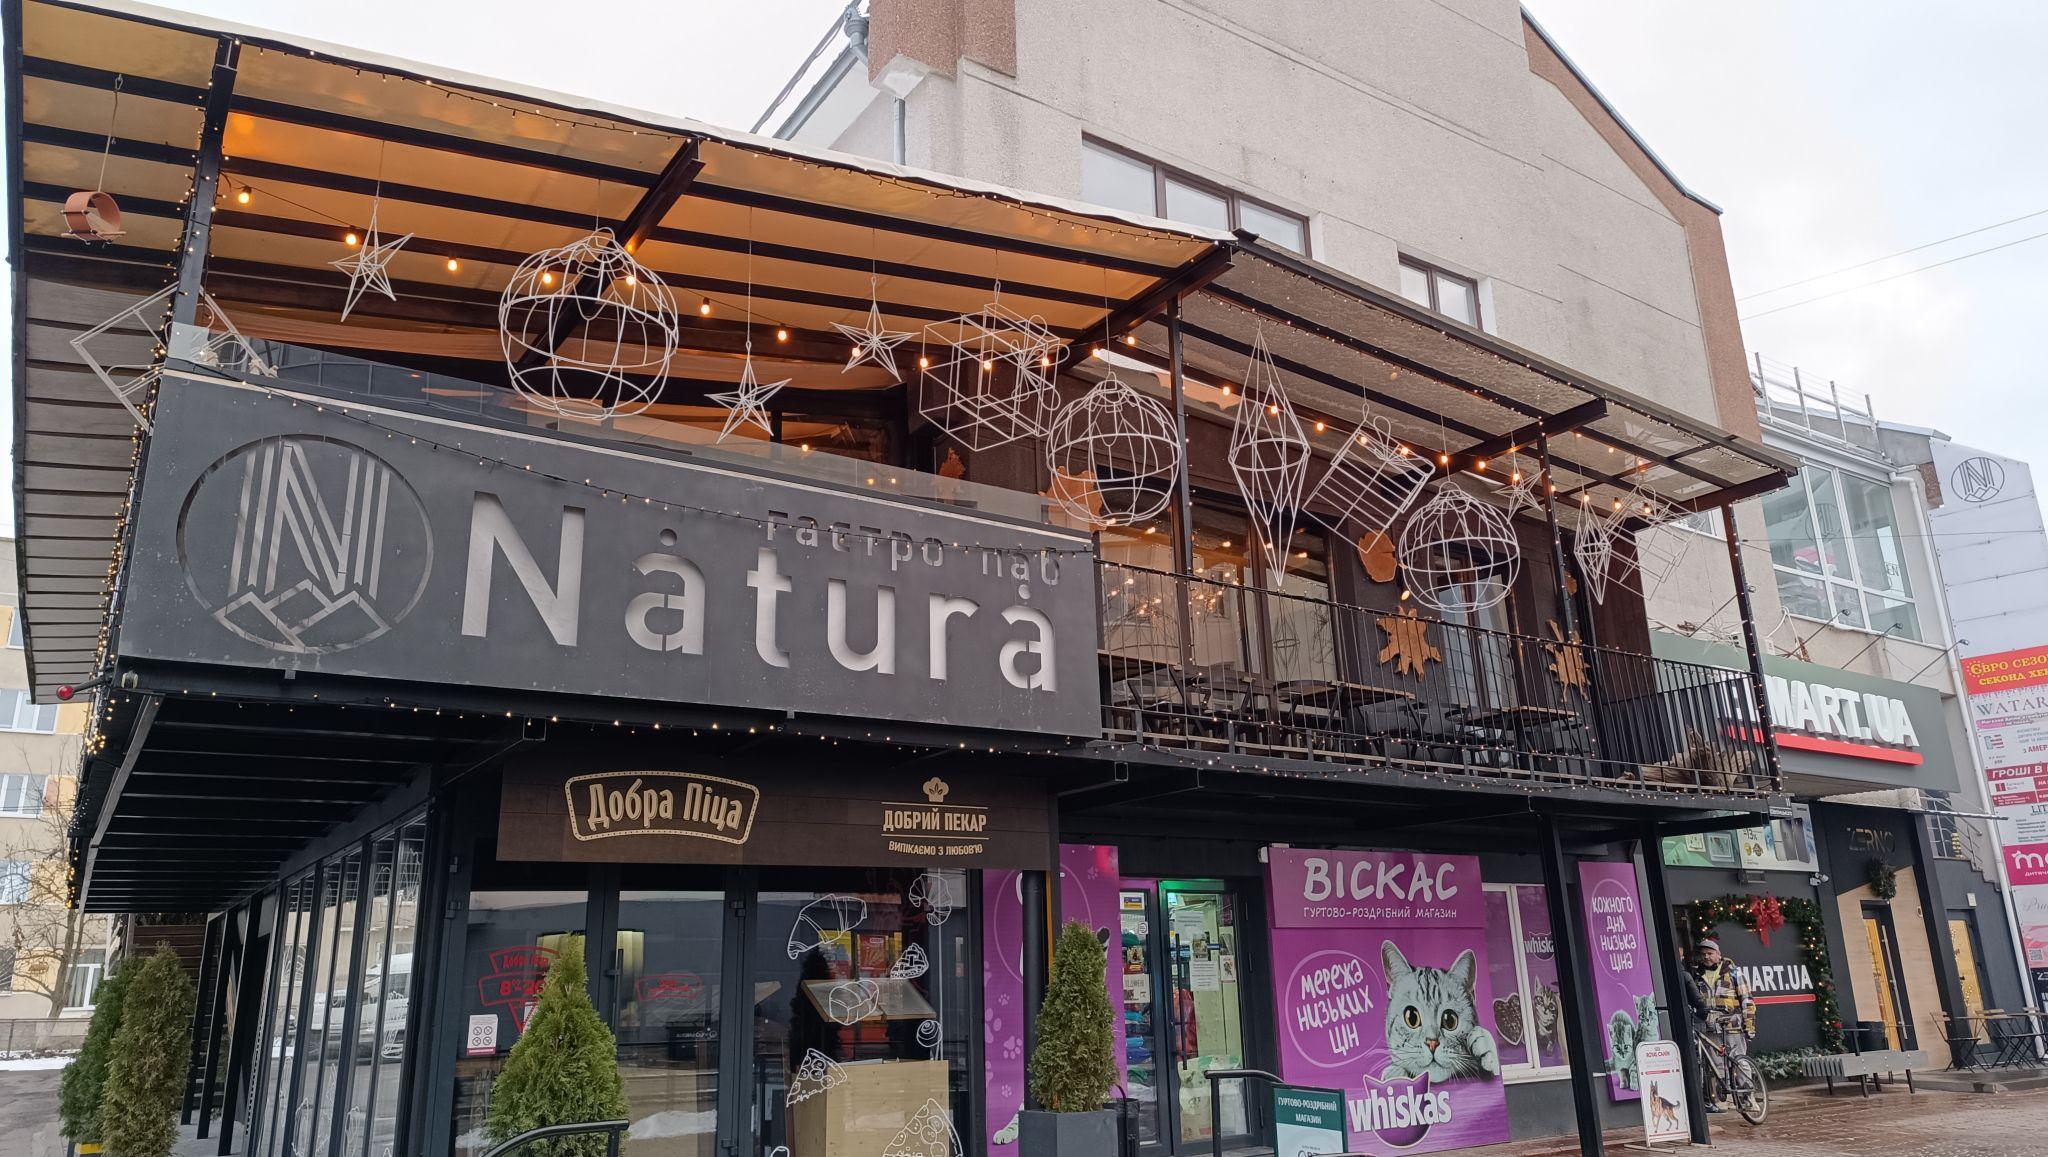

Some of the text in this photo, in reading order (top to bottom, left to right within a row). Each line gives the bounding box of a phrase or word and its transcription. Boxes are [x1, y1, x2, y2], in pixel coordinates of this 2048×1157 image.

[768, 510, 1060, 586] гастро паб
[2012, 654, 2048, 668] СЕЗО
[1992, 766, 2031, 779] ГРОШІ
[587, 778, 743, 832] Добра Піца
[882, 807, 987, 832] ДОБРИЙ ПЕКАР
[888, 840, 936, 856] ВИПІКАЄМО
[1303, 857, 1458, 903] ВІСКАС
[1303, 906, 1457, 919] ГУРТОВО-РОЗДРІБНИЙ МАГАЗИН
[1524, 936, 1555, 953] whiska
[1277, 1097, 1337, 1112] ГУРТОВО-РОЗДРІБНИЙ
[1348, 1085, 1452, 1133] whiskas
[1295, 1113, 1322, 1124] МАГАЗИН
